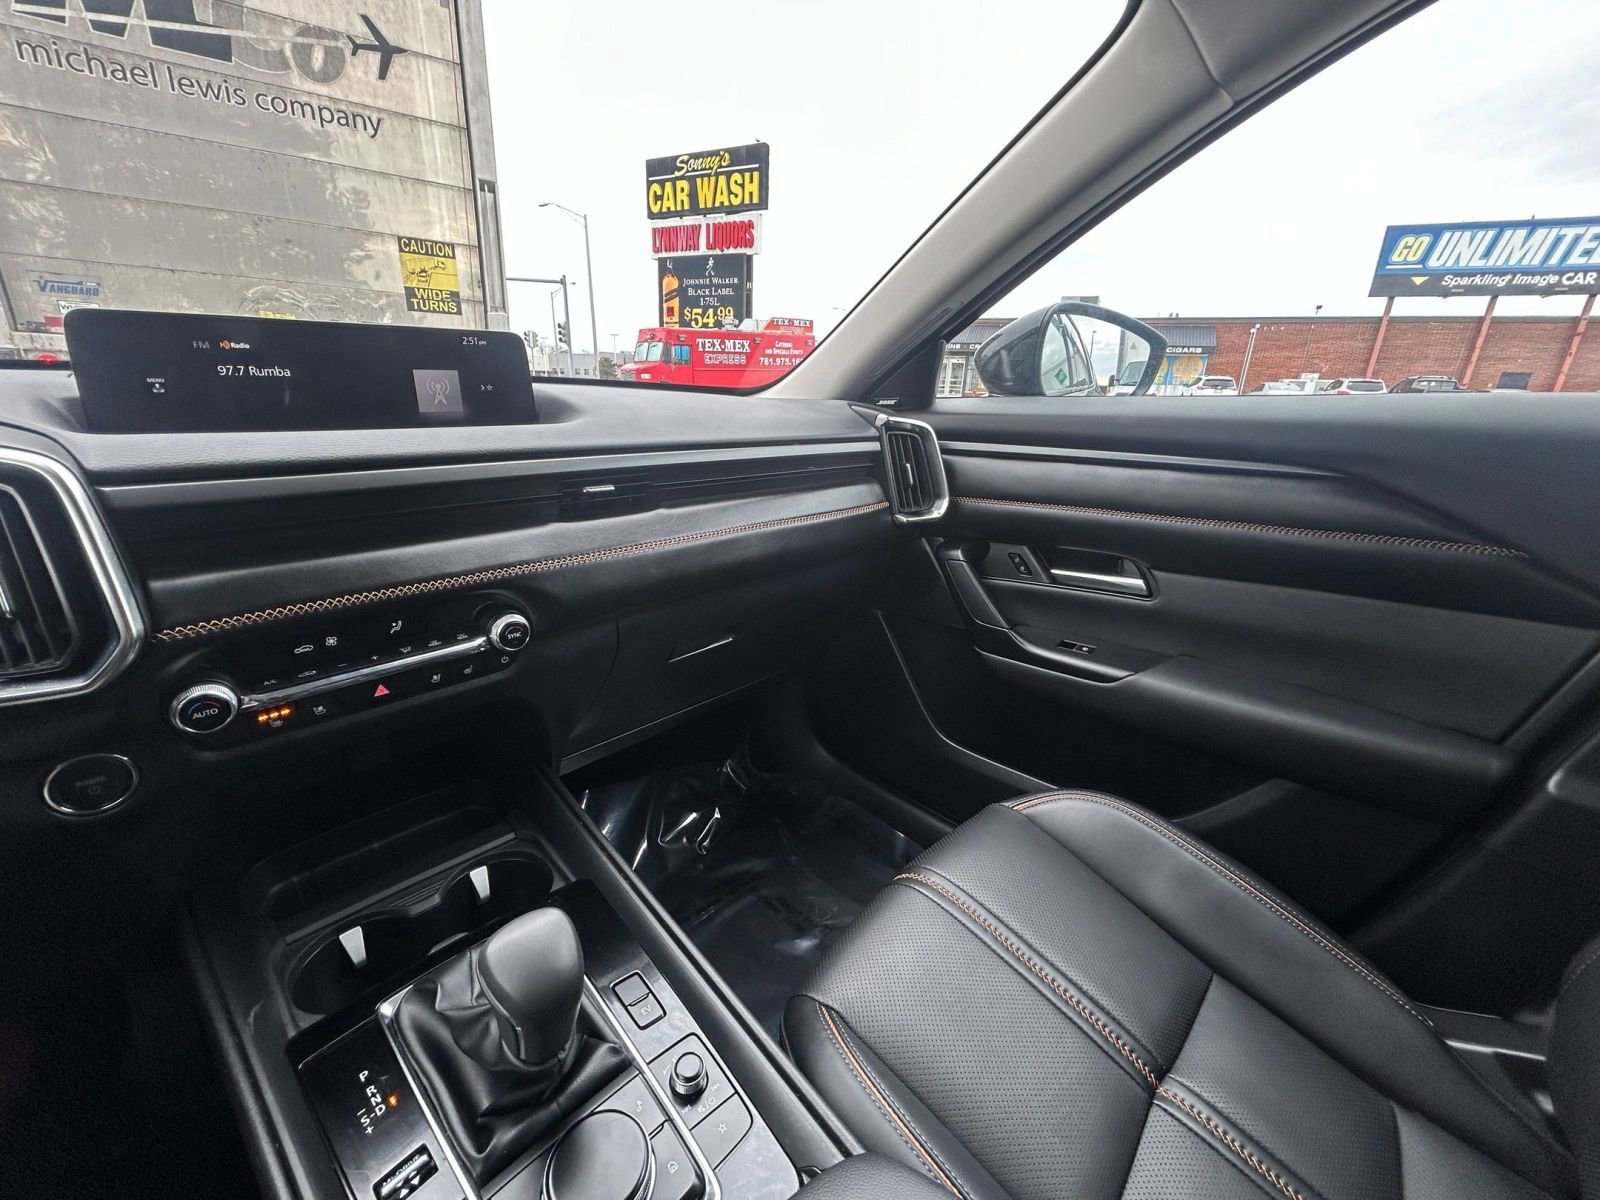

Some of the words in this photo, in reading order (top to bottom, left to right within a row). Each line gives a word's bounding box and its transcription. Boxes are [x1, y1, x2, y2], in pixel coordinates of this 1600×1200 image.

[14, 36, 159, 90] michael
[166, 65, 247, 107] lewis
[254, 92, 382, 138] company
[674, 150, 731, 176] Sonny's
[648, 179, 691, 214] CAR
[695, 171, 760, 209] WASH
[652, 223, 702, 254] LYNNWAY
[705, 219, 755, 253] LIQUORS
[401, 238, 454, 258] CAUTION
[1391, 235, 1431, 263] GO
[682, 278, 710, 287] JOHNNIE
[1441, 274, 1510, 288] Sparkling
[1512, 273, 1559, 286] Image
[1561, 271, 1597, 285] CAR
[35, 279, 100, 297] VANGUARD
[414, 287, 452, 302] WIDE
[687, 288, 710, 296] BLACK
[711, 286, 735, 296] LABEL
[411, 298, 458, 314] TURNS
[684, 306, 734, 329] $54.99
[193, 340, 210, 349] FM
[230, 341, 250, 349] Radio
[217, 365, 245, 376] 97.7
[248, 365, 291, 377] Rumba
[507, 631, 522, 640] SYNC
[192, 707, 219, 720] AUTO
[640, 1004, 653, 1016] EV
[359, 1070, 369, 1082] P
[366, 1085, 377, 1097] R
